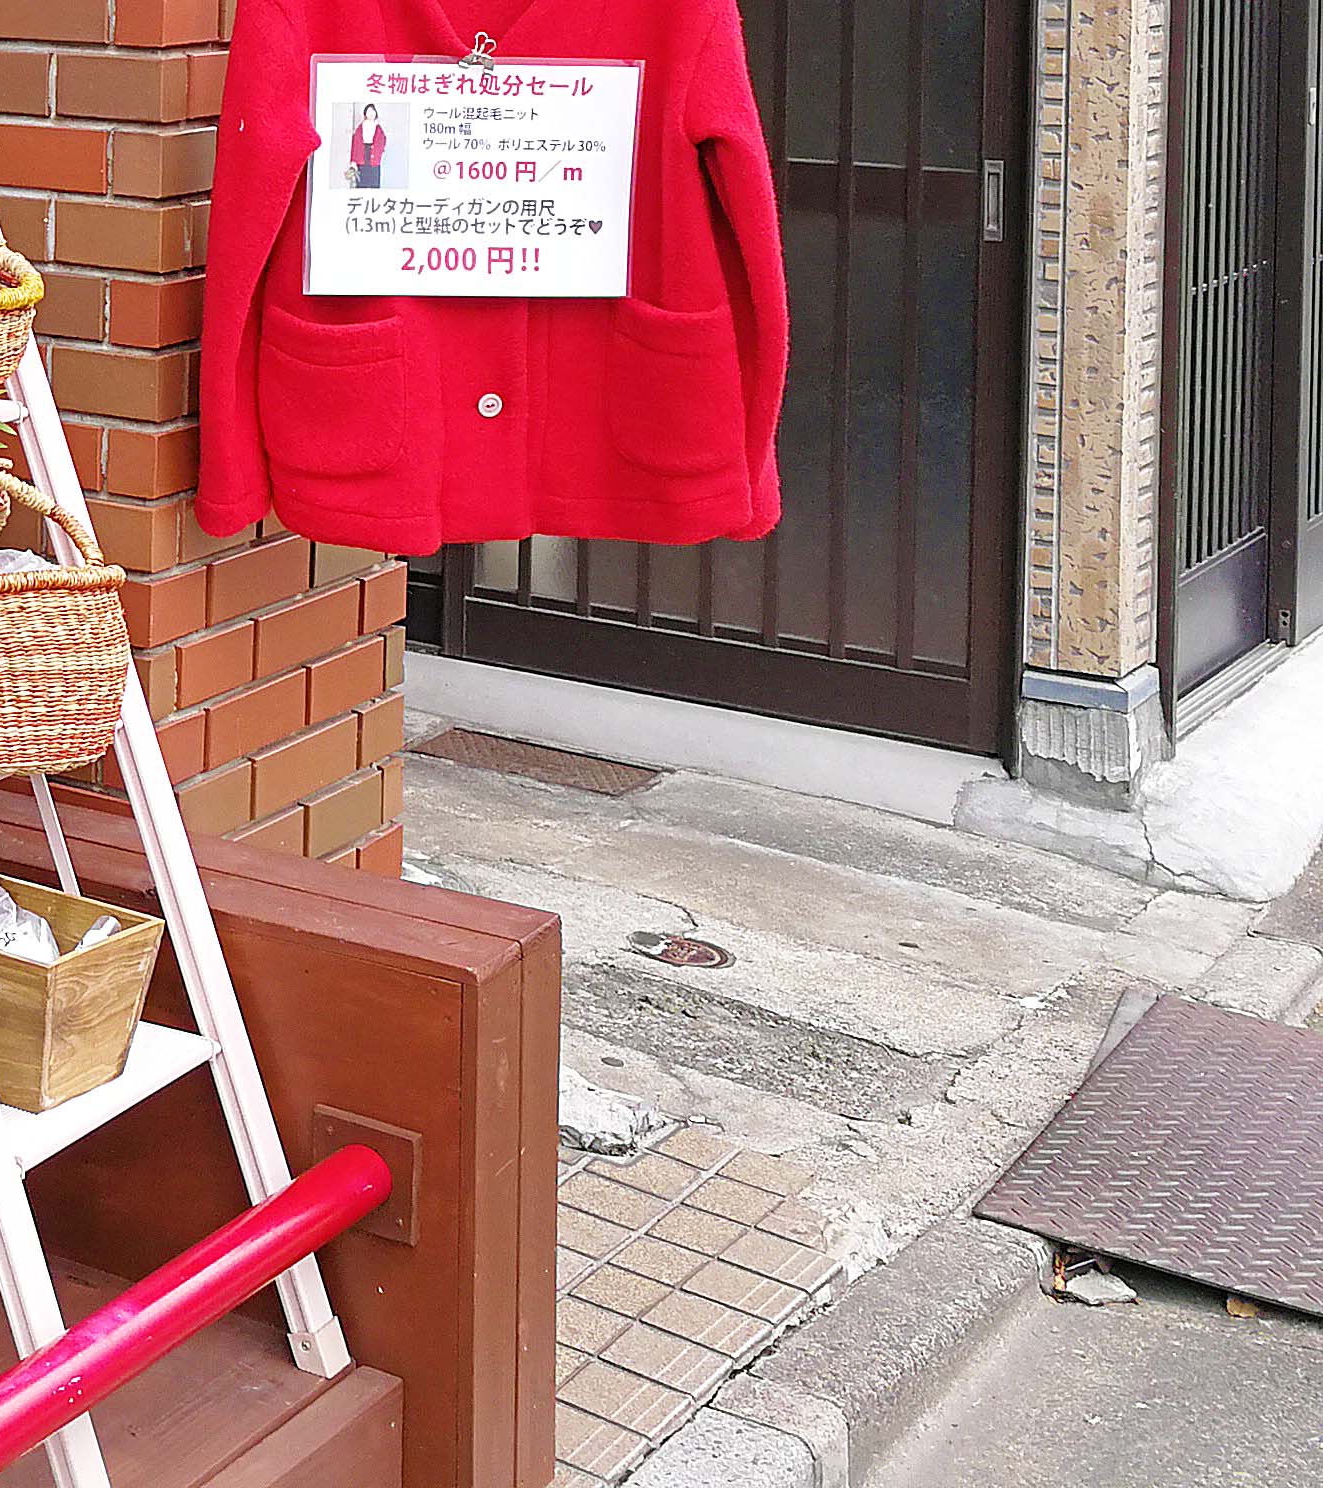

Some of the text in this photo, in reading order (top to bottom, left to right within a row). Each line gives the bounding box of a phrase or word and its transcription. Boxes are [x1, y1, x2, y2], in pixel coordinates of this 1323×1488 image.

[366, 72, 594, 97] 冬物はぎれ処分セール
[346, 197, 556, 218] デルタカーディガンの用尺
